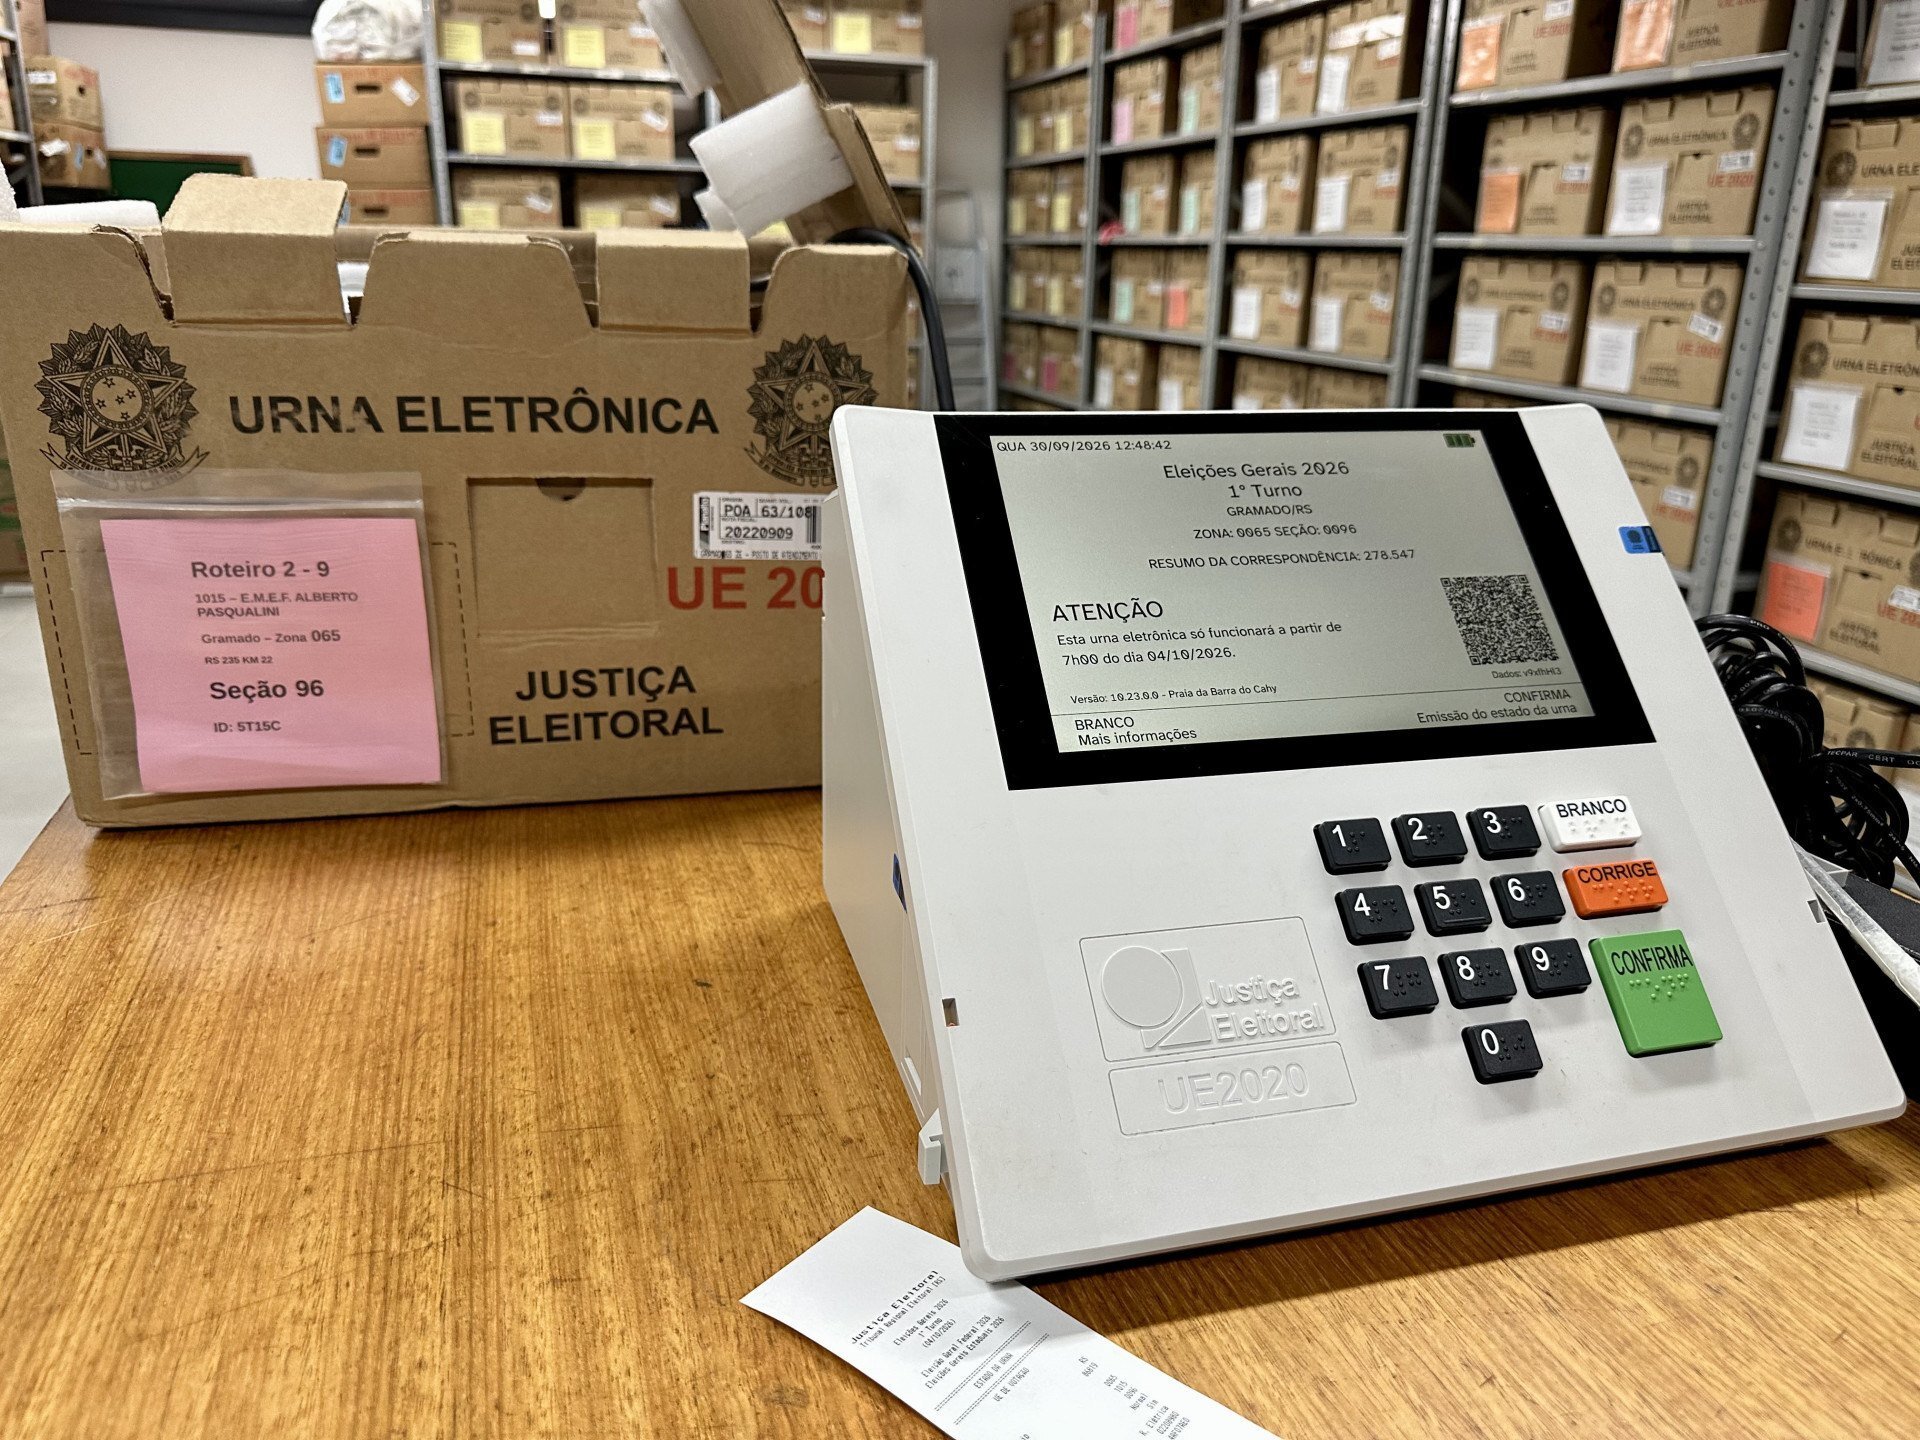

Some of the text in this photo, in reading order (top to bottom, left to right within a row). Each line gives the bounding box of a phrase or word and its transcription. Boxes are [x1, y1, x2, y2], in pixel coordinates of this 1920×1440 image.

[1861, 164, 1895, 178] URNA
[229, 387, 720, 434] URNA ELETRÔNICA
[997, 440, 1172, 452] QUA 30/09/2026 12:48:42
[1163, 462, 1349, 481] Eleições Gerais 2026
[1250, 484, 1302, 498] Turno
[724, 504, 751, 518] POA
[761, 506, 813, 519] 63/108
[1226, 504, 1313, 516] GRAMADO/RS
[725, 526, 794, 540] 20220909
[1193, 524, 1357, 539] ZONA: 0065 SEÇÃO: 0096
[190, 560, 276, 578] Roteiro
[282, 561, 294, 578] 2
[317, 560, 330, 577] 9
[1149, 549, 1415, 569] RESUMO DA CORRESPONDÊNCIA: 278.547
[195, 593, 226, 604] 1015
[240, 592, 292, 603] E.M.E.F.
[295, 591, 358, 603] ALBERTO
[668, 566, 747, 610] UE
[197, 606, 280, 619] PASQUALINI
[1052, 598, 1164, 624] ATENÇÃO
[201, 632, 261, 644] Gramado
[274, 632, 307, 644] Zona
[311, 629, 341, 643] 065
[1057, 620, 1342, 646] Esta urna eletrônica só funcionará a partir de
[204, 656, 273, 664] RS 235 KM 22
[1062, 646, 1236, 666] 7h00 do dia 04/10/2026.
[516, 665, 696, 702] JUSTIÇA
[1492, 669, 1522, 679] Dados:
[209, 678, 324, 704] Seção 96
[1070, 693, 1108, 705] Versão:
[1110, 690, 1159, 702] 10.23.0.0
[1168, 689, 1194, 700] Praia
[1196, 688, 1208, 698] da
[1210, 686, 1237, 697] Barra
[1238, 684, 1252, 695] do
[1253, 684, 1277, 696] Cahy
[1504, 688, 1571, 704] CONFIRMA
[1074, 716, 1134, 732] BRANCO
[1416, 703, 1578, 724] Emissão do estado da urna
[214, 720, 282, 734] ID: 5T15C
[489, 707, 724, 745] ELEITORAL
[1078, 728, 1198, 747] Mais informações
[1556, 798, 1627, 818] BRANCO
[1408, 818, 1428, 841] 2
[1483, 812, 1502, 834] 3
[1332, 824, 1347, 848] 1
[1577, 860, 1657, 884] CORRIGE
[1433, 885, 1451, 910] 5
[1508, 878, 1526, 902] 6
[1354, 893, 1372, 917] 4
[1456, 955, 1475, 981] 8
[1530, 946, 1550, 972] 9
[1611, 943, 1694, 977] CONFIRMA
[1374, 964, 1392, 991] 7
[1205, 974, 1300, 1005] Justiça
[1211, 1002, 1324, 1042] Eleitoral
[1480, 1028, 1500, 1056] 0
[1157, 1062, 1310, 1114] UE2020
[852, 1270, 938, 1344] Justiça Eleitoral
[860, 1327, 884, 1348] Tribunal
[886, 1308, 908, 1328] Regional
[906, 1286, 934, 1309] Eleitoral
[893, 1298, 949, 1346] Eleições Gerais 2026
[922, 1318, 956, 1349] (04/10/2026)
[927, 1318, 943, 1332] Turno
[942, 1343, 960, 1358] Geral
[957, 1326, 979, 1345] Federal
[977, 1314, 991, 1327] 2026
[949, 1350, 969, 1367] Gerais
[966, 1327, 994, 1352] Estaduais
[992, 1316, 1005, 1330] 2026
[973, 1370, 994, 1390] ESTADO
[991, 1363, 1002, 1373] DA
[993, 1392, 1004, 1402] UE
[1000, 1384, 1010, 1395] DE
